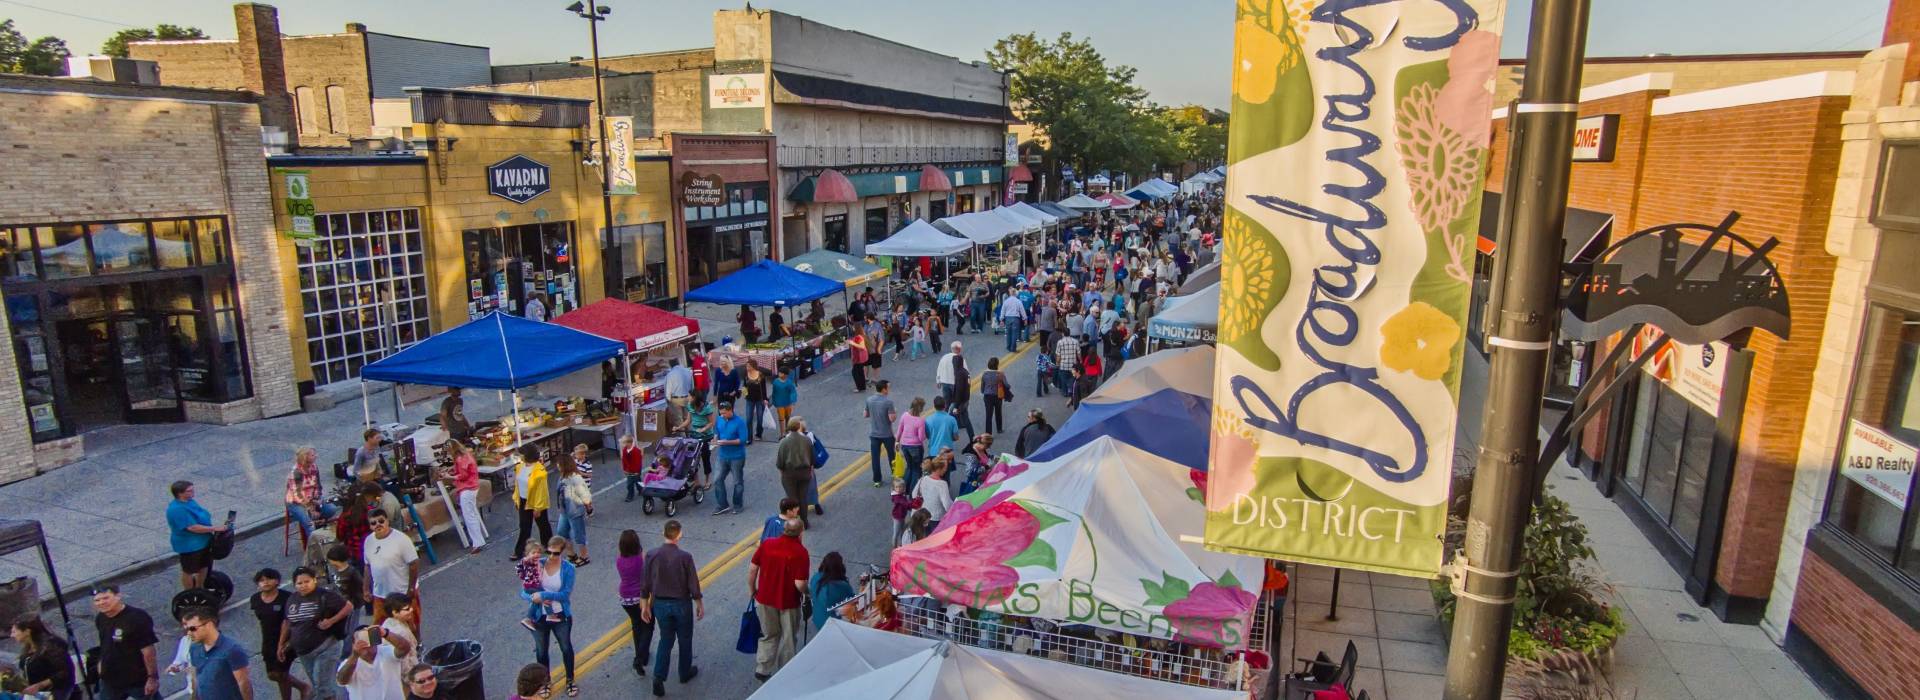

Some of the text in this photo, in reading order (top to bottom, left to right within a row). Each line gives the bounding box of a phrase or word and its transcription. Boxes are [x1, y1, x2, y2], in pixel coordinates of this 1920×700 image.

[495, 167, 546, 187] KAVARNA
[691, 178, 713, 189] String
[684, 187, 721, 196] Instrument
[686, 195, 720, 205] Workshop
[288, 199, 315, 216] vibe
[1854, 428, 1894, 453] AVAILABLE
[1848, 456, 1914, 476] A&D Realty
[1233, 492, 1417, 544] DISTRICT
